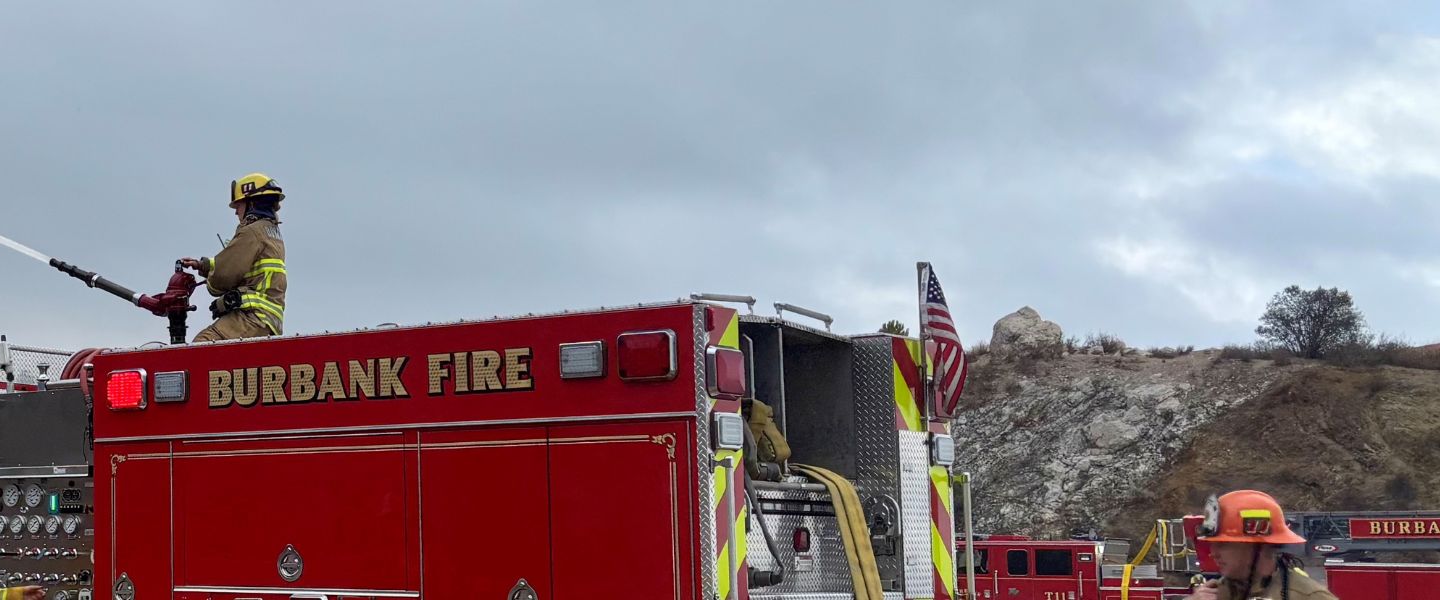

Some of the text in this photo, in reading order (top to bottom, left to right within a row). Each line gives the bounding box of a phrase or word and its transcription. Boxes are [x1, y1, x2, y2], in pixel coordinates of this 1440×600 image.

[208, 347, 535, 408] BURBANK FIRE
[1369, 520, 1440, 535] BURBA
[1044, 591, 1066, 600] T11
